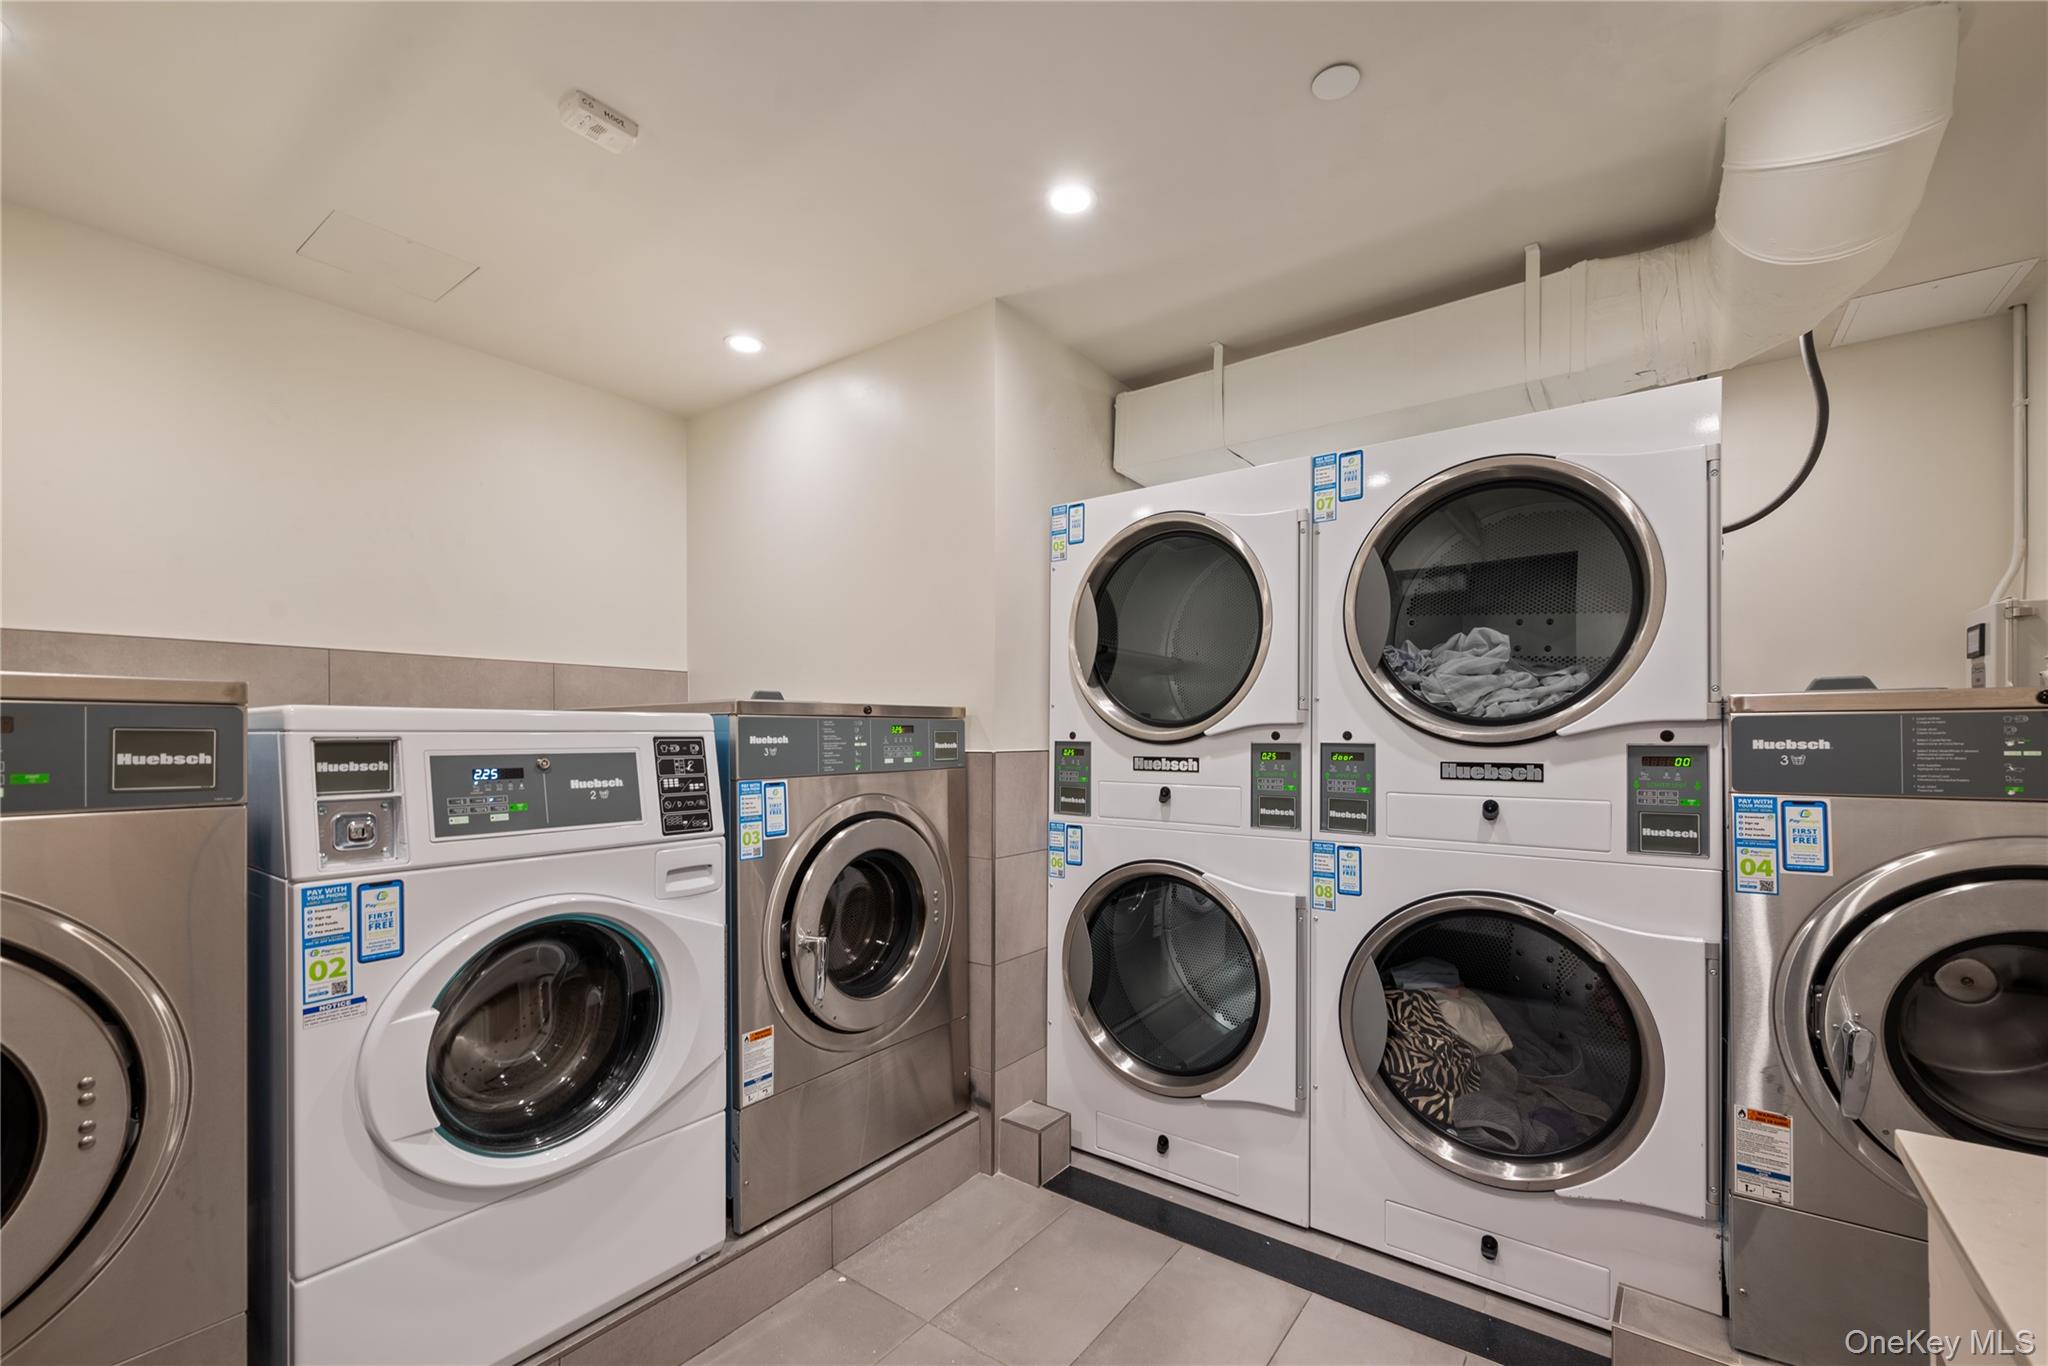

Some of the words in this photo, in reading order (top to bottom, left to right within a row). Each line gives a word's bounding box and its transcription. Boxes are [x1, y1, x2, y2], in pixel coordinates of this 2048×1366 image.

[1316, 496, 1333, 511] 07
[1053, 541, 1065, 552] 05
[749, 735, 789, 745] Huebsch
[1752, 739, 1831, 750] Huebsch
[763, 747, 770, 757] 3
[116, 753, 212, 766] Huebsch
[1134, 757, 1198, 772] Huebsch
[1780, 755, 1789, 766] 3
[316, 760, 389, 773] Huebsch
[1442, 763, 1543, 781] Huebsch
[570, 777, 624, 789] Huebsch
[590, 790, 597, 800] 2
[1260, 808, 1295, 816] Huebsch
[1329, 810, 1367, 820] Huebsch
[742, 830, 760, 846] 03
[1642, 827, 1698, 839] Huebsch
[1792, 837, 1818, 845] FREE
[1052, 857, 1063, 868] 06
[1740, 858, 1774, 877] 04
[307, 888, 323, 897] PAY
[324, 885, 347, 895] WITH
[326, 891, 347, 899] PHONE
[1315, 884, 1333, 899] 08
[368, 910, 394, 920] FIRST
[368, 920, 394, 931] FREE
[309, 956, 347, 982] 02
[319, 1000, 352, 1012] NOTICE
